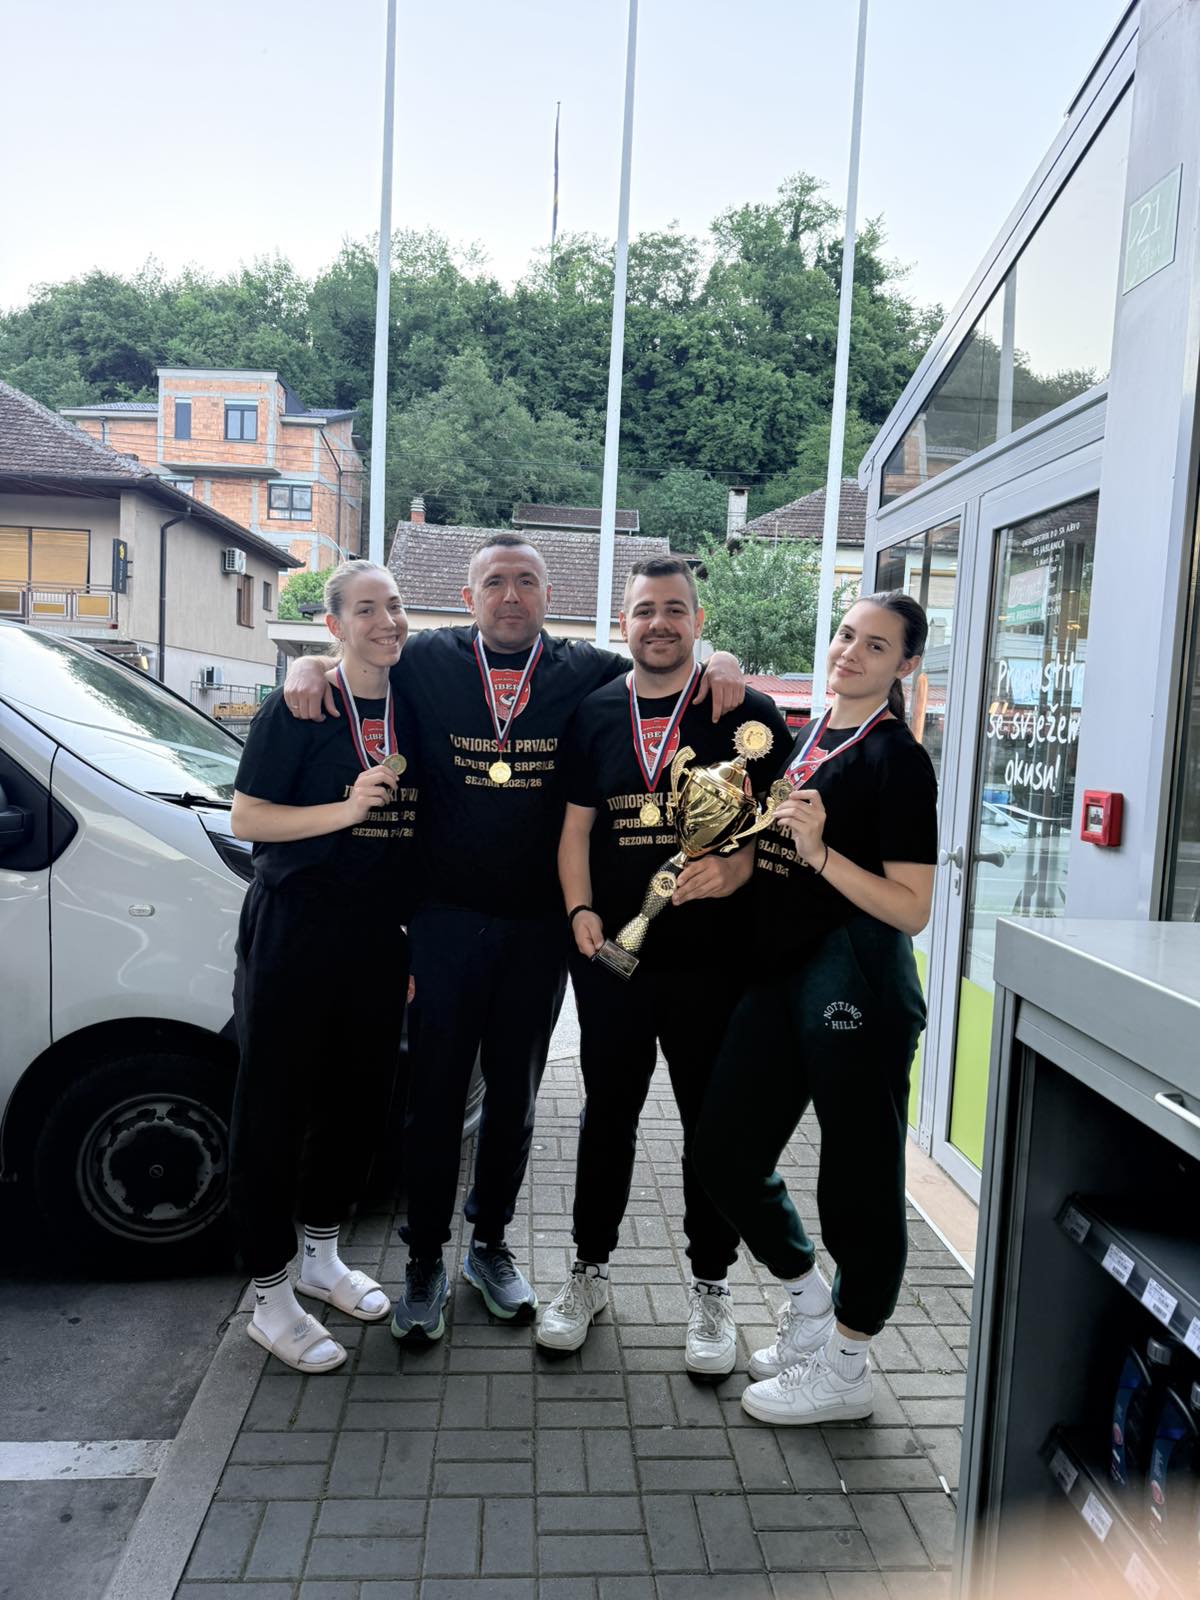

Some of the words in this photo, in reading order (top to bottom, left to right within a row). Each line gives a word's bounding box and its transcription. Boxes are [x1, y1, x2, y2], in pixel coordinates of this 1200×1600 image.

[986, 712, 1004, 740] se
[1004, 752, 1061, 793] okusu!
[502, 778, 543, 789] 2025/26
[351, 827, 389, 838] SEZONA
[618, 836, 653, 846] SEZONA
[823, 1001, 862, 1020] NOTTING
[831, 1020, 858, 1030] HILL
